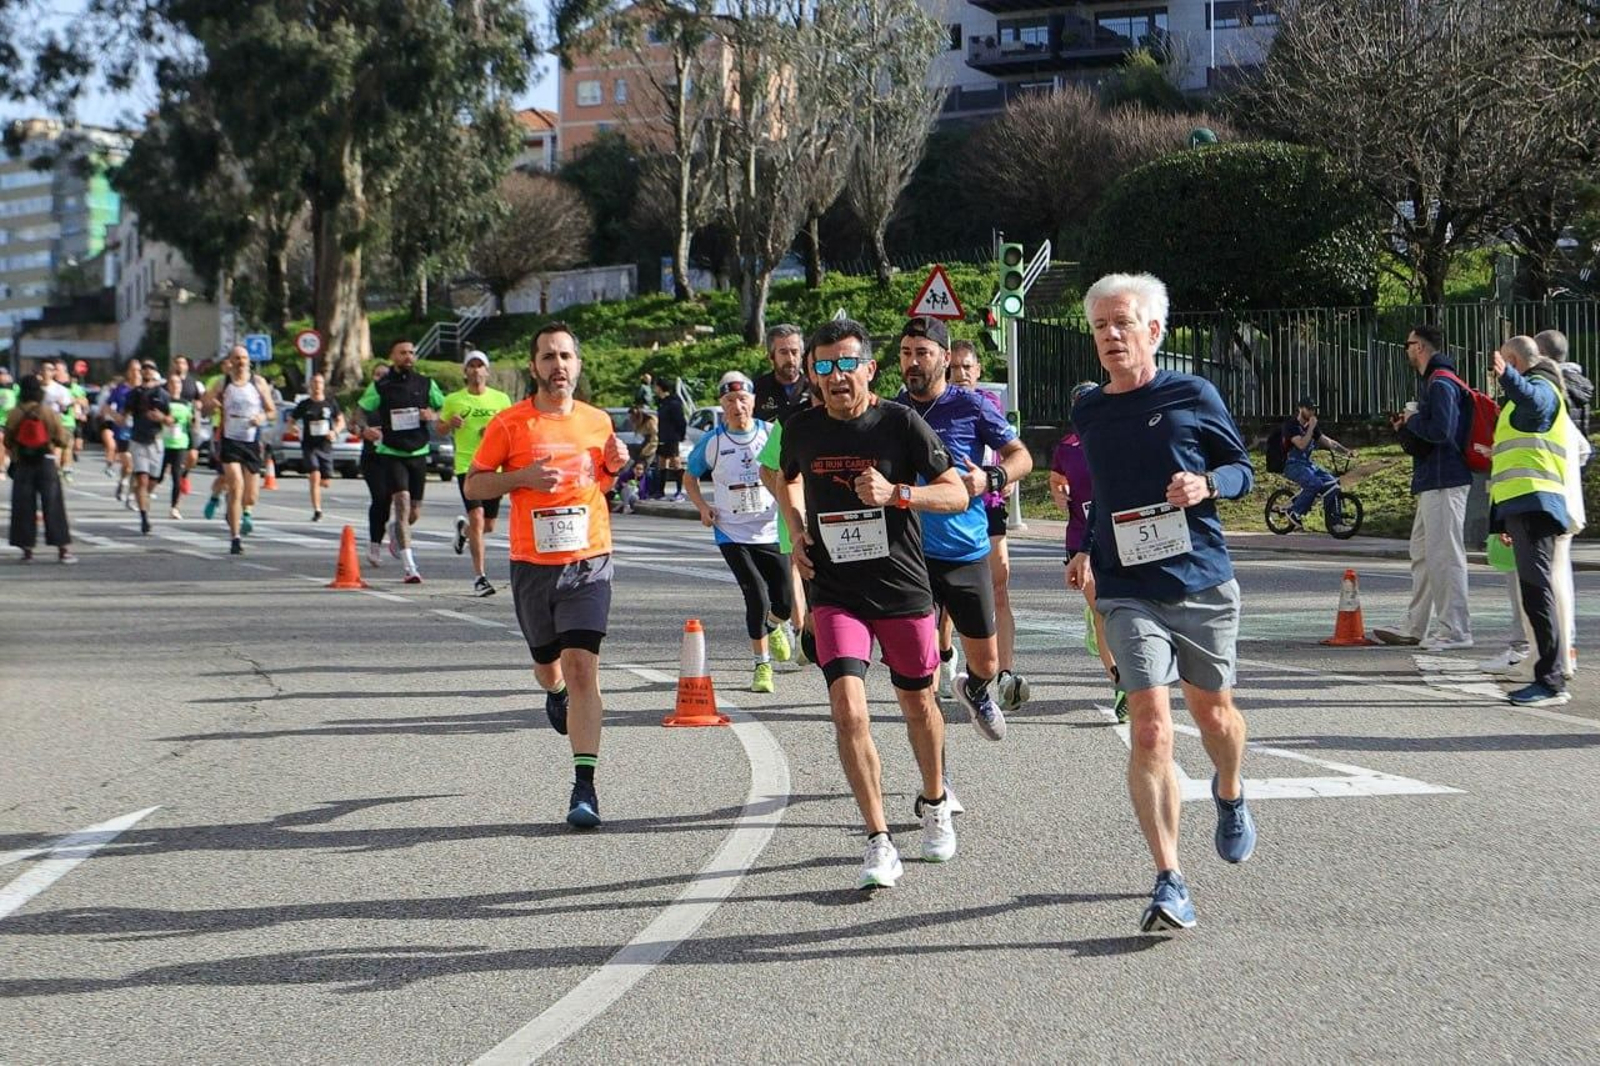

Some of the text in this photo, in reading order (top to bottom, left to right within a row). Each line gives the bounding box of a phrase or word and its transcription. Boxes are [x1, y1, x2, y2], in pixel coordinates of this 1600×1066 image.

[550, 520, 574, 535] 194
[841, 527, 861, 542] 44
[1139, 523, 1159, 542] 51
